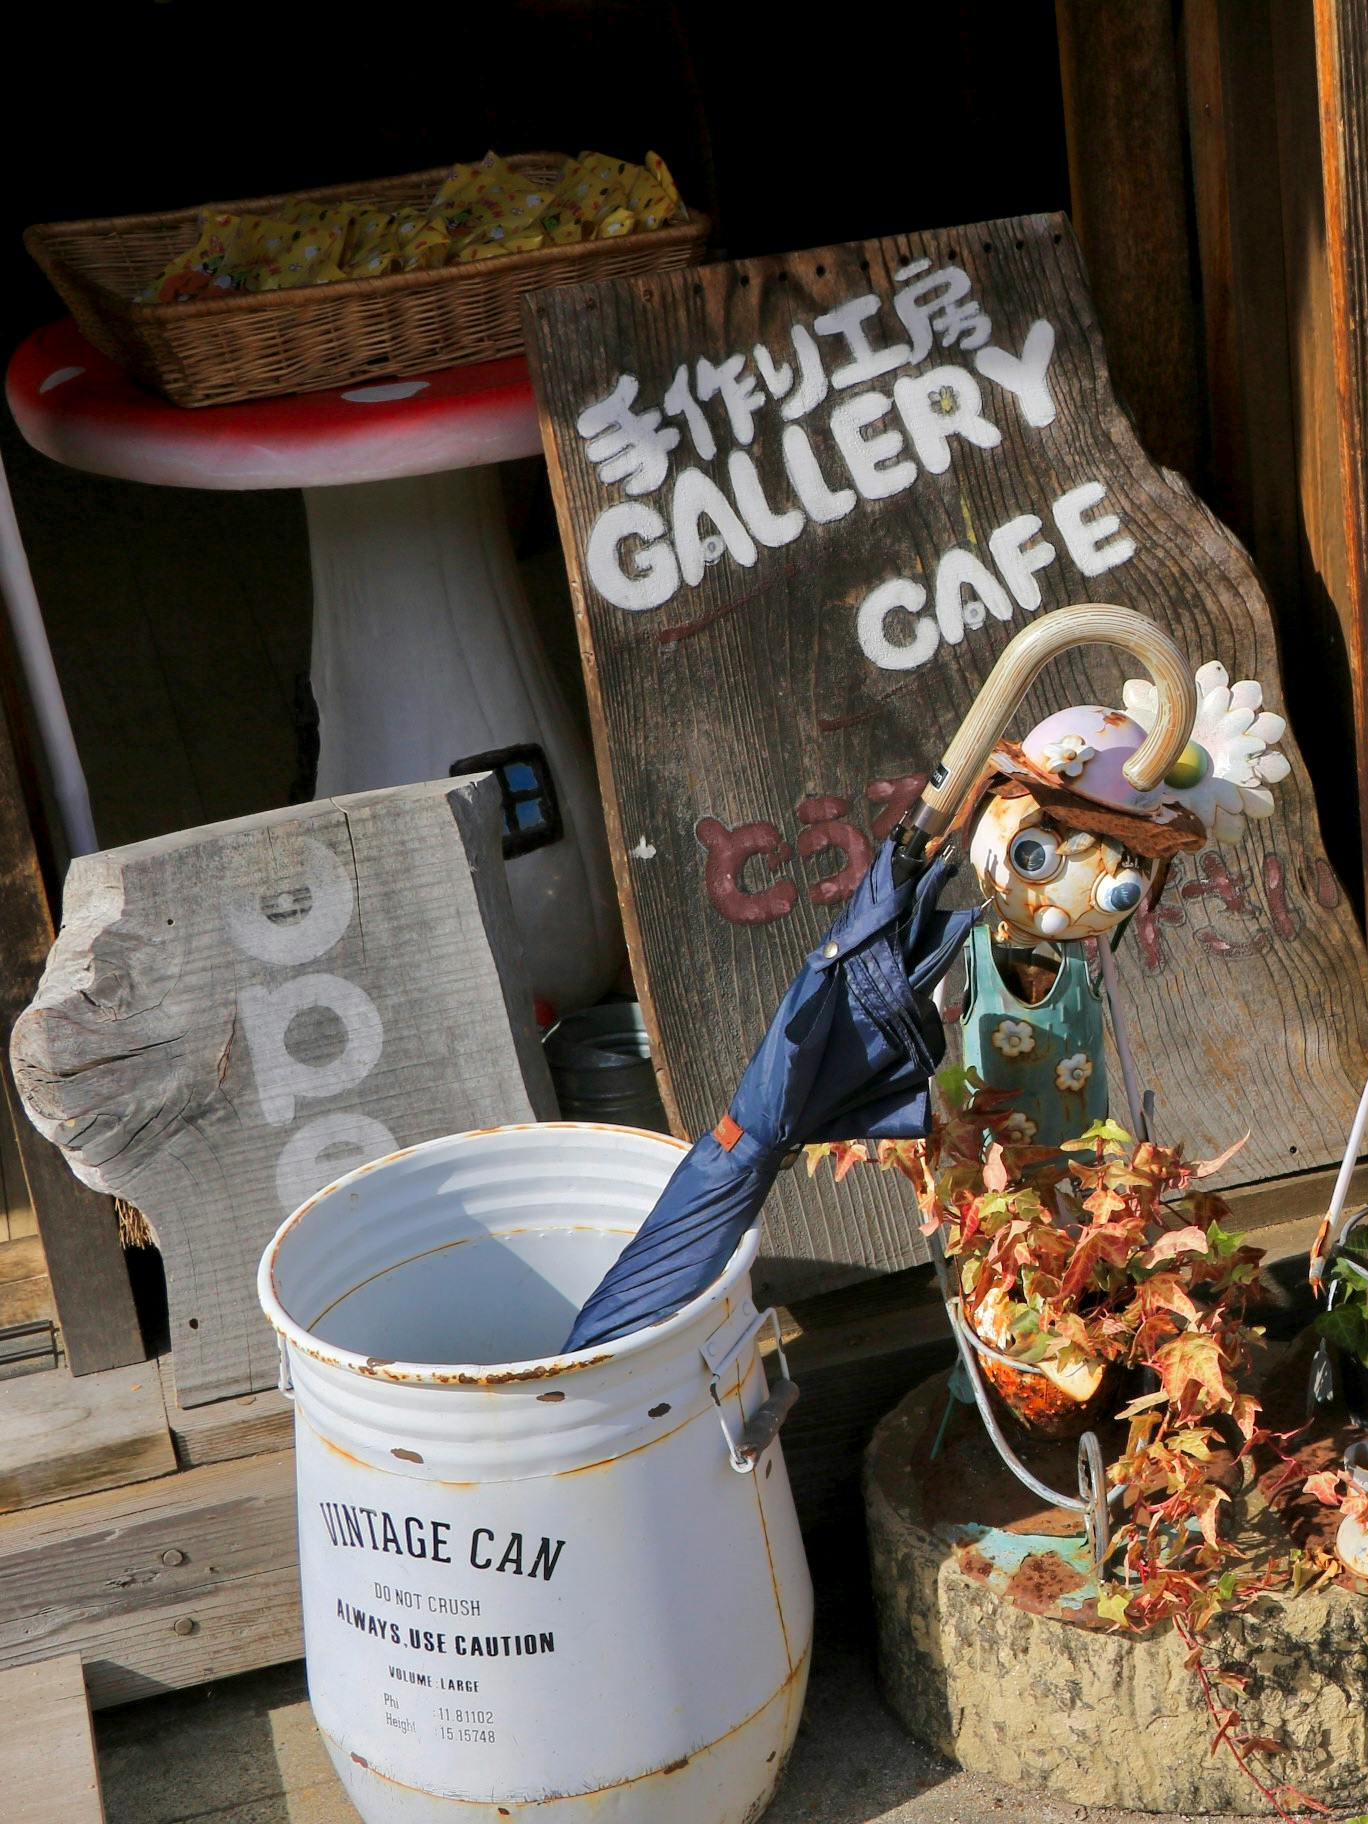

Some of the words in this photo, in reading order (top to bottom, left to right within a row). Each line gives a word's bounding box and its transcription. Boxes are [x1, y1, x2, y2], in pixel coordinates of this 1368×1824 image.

[577, 258, 992, 497] 手作り工房
[587, 319, 1056, 611] GALLERY
[857, 481, 1137, 671] CAFE
[320, 1502, 451, 1563] VINTAGE
[470, 1528, 566, 1581] CAN
[374, 1581, 391, 1602] DO
[395, 1588, 422, 1610] NOT
[428, 1595, 480, 1616] CRUSH
[455, 1632, 555, 1657] CAUTION
